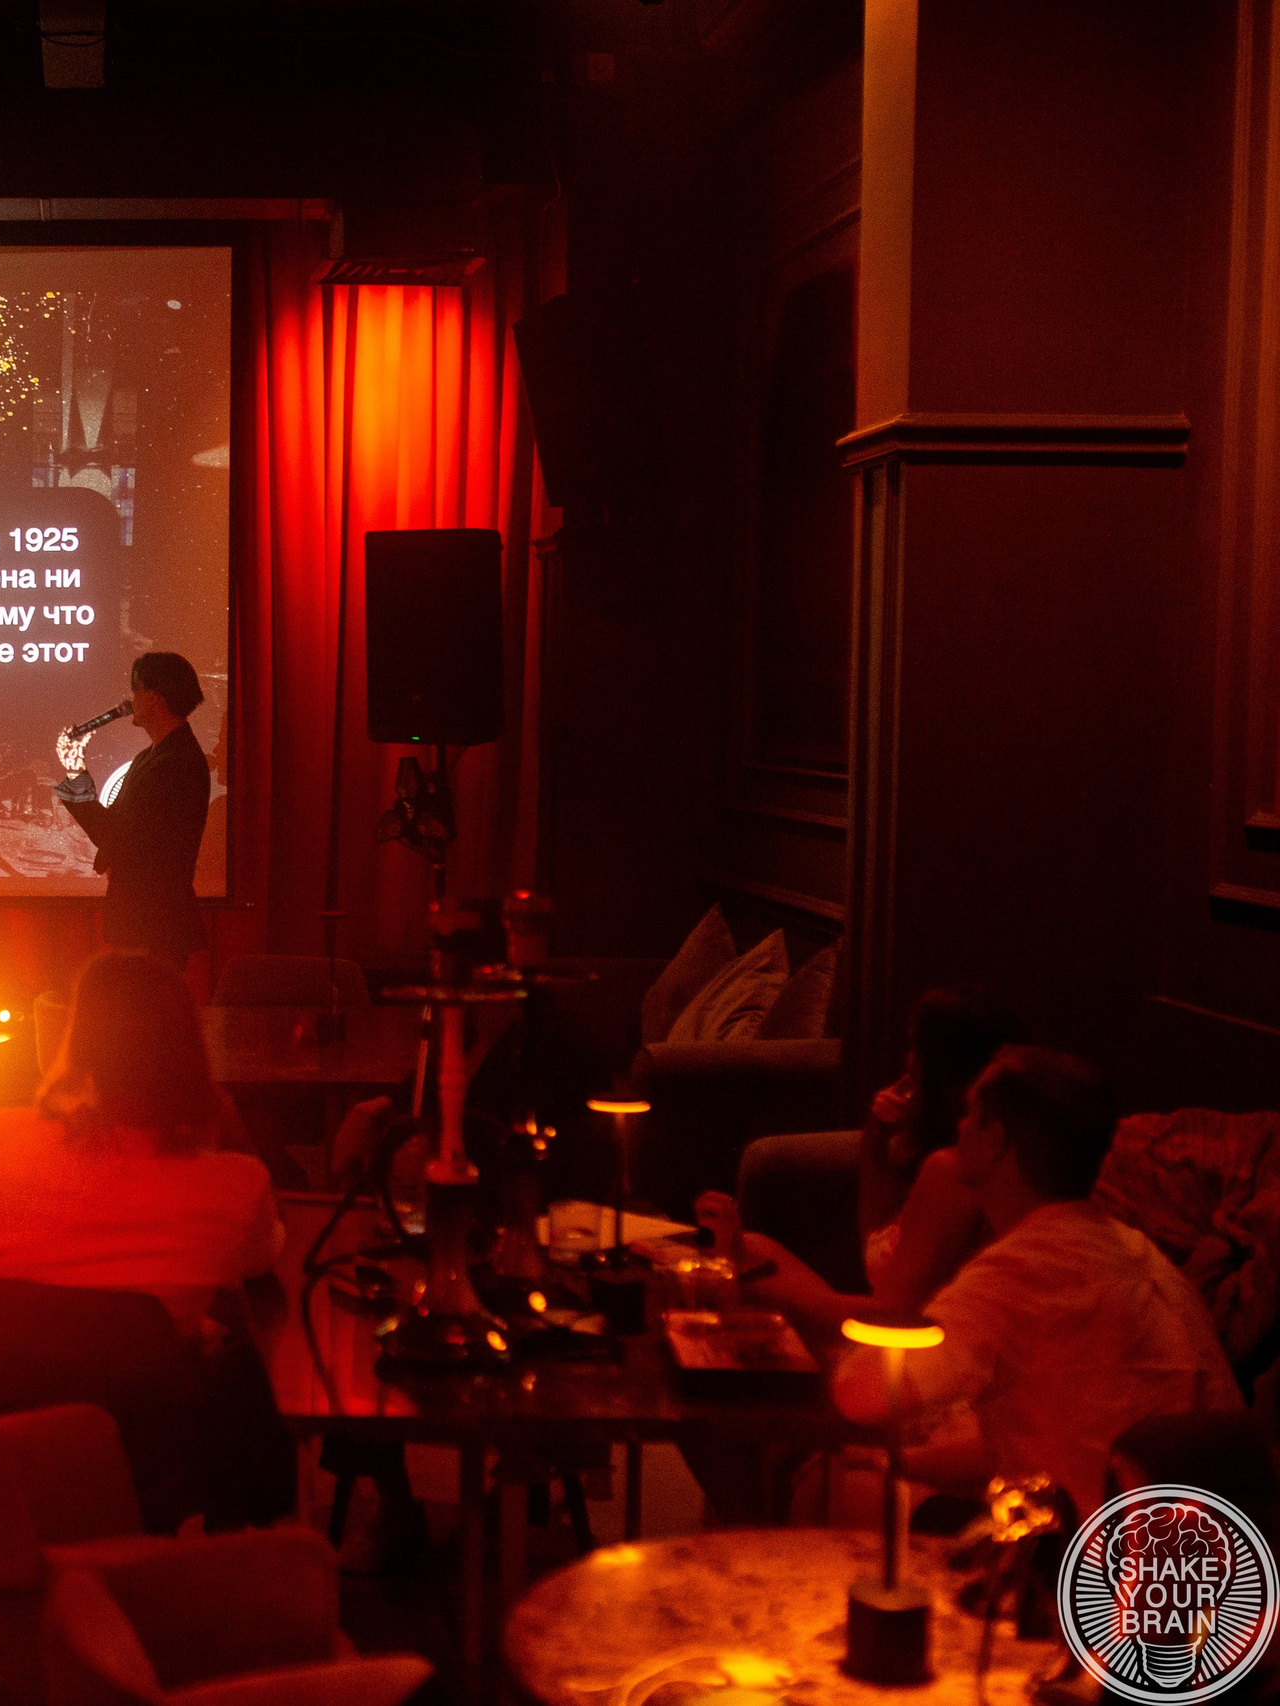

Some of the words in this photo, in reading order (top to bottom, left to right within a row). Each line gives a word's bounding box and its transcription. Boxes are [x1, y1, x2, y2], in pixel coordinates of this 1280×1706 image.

[9, 527, 79, 553] 1925
[45, 568, 81, 588] ни
[43, 605, 95, 625] что
[22, 642, 90, 663] этот
